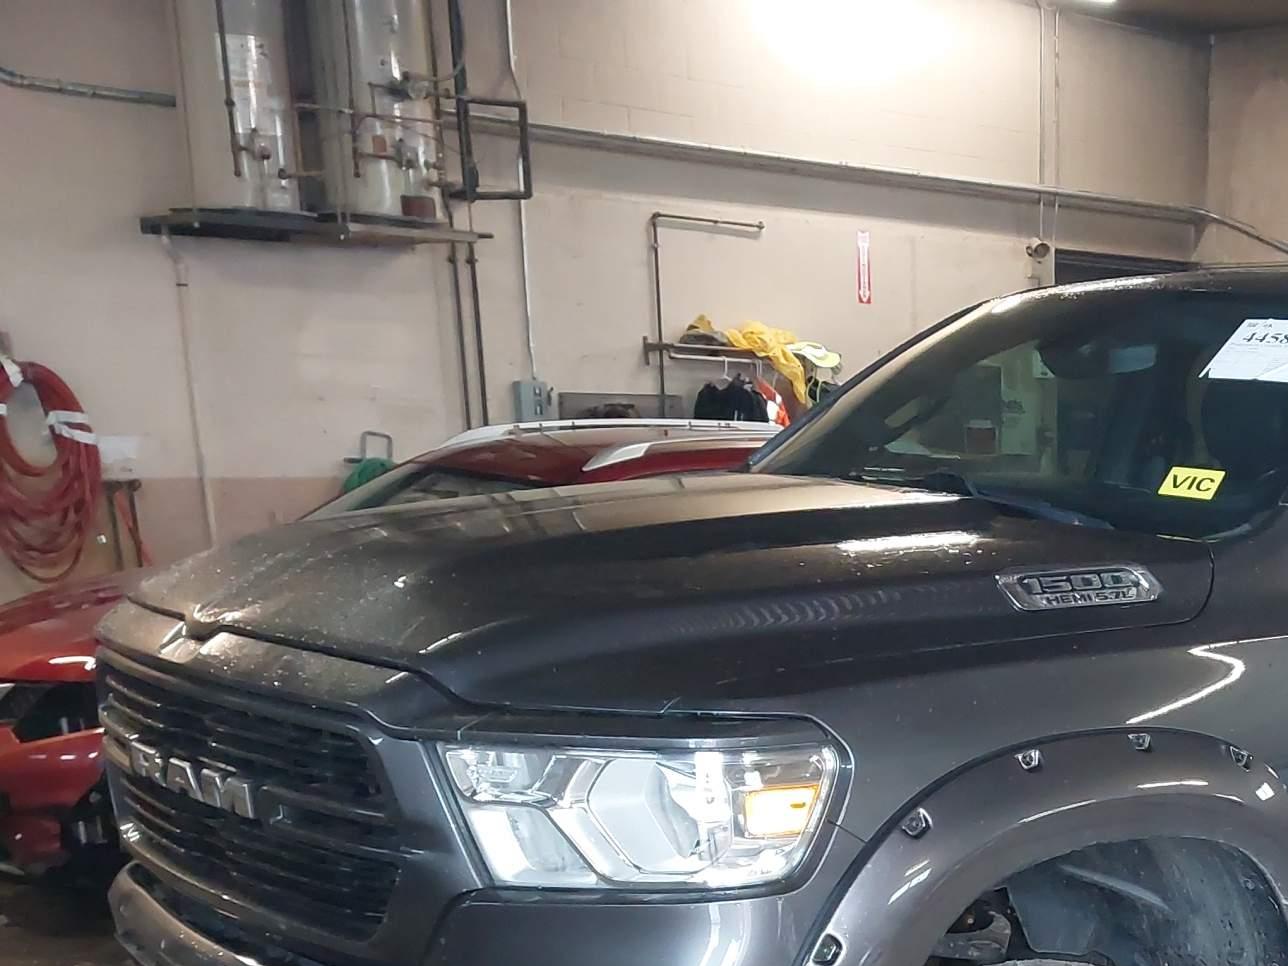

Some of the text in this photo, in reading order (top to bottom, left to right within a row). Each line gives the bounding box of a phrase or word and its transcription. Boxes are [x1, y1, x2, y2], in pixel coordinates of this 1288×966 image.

[1172, 473, 1216, 492] VIC
[1021, 570, 1139, 595] 1500
[1046, 588, 1137, 605] HEMI 5.7L
[129, 740, 255, 819] RAM
